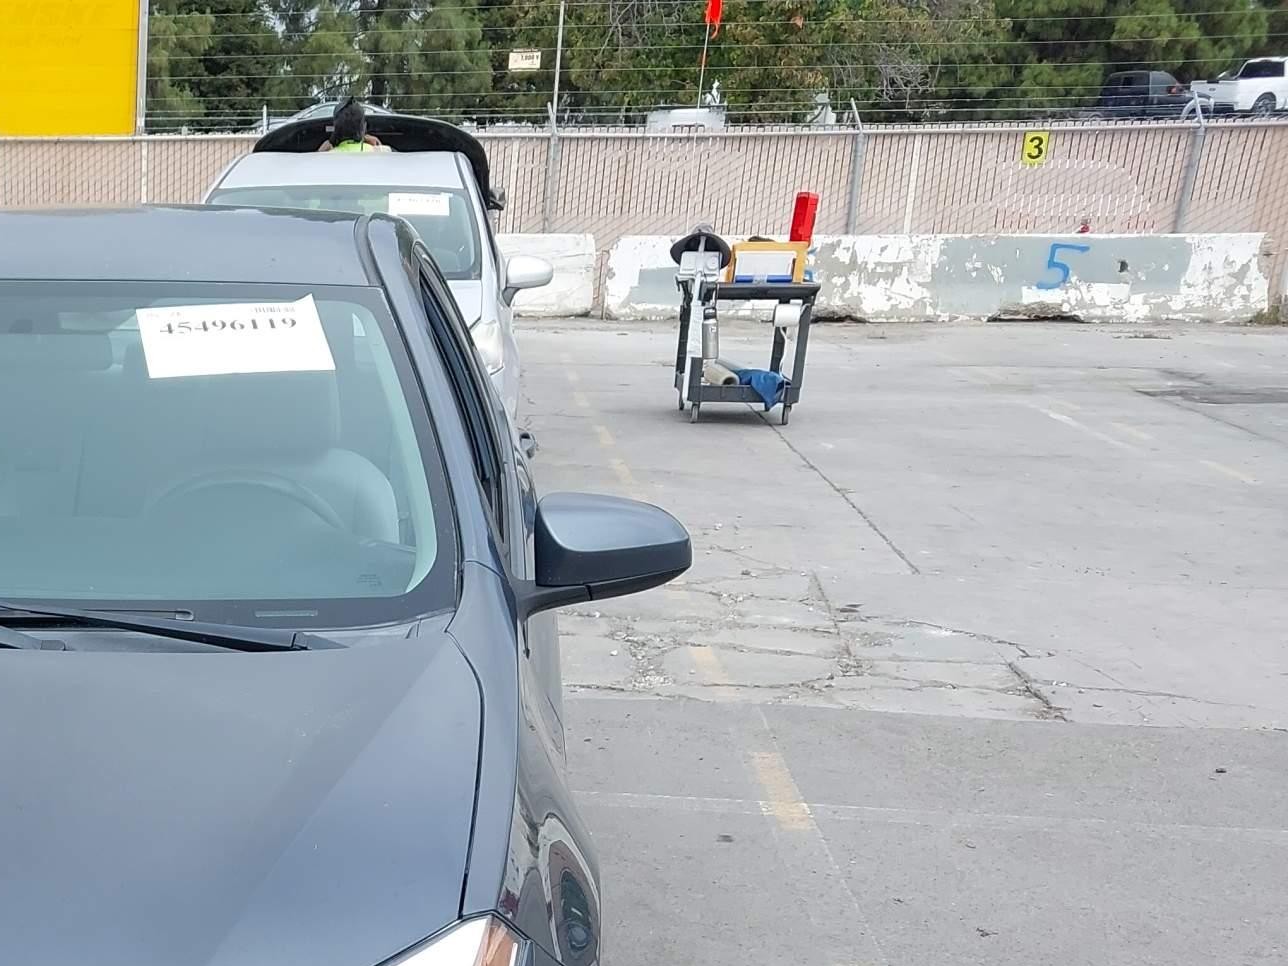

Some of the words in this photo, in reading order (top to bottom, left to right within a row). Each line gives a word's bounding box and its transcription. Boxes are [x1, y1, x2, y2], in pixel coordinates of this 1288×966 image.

[1027, 135, 1043, 160] 3
[1036, 243, 1090, 290] 5
[159, 318, 297, 334] 45496119
